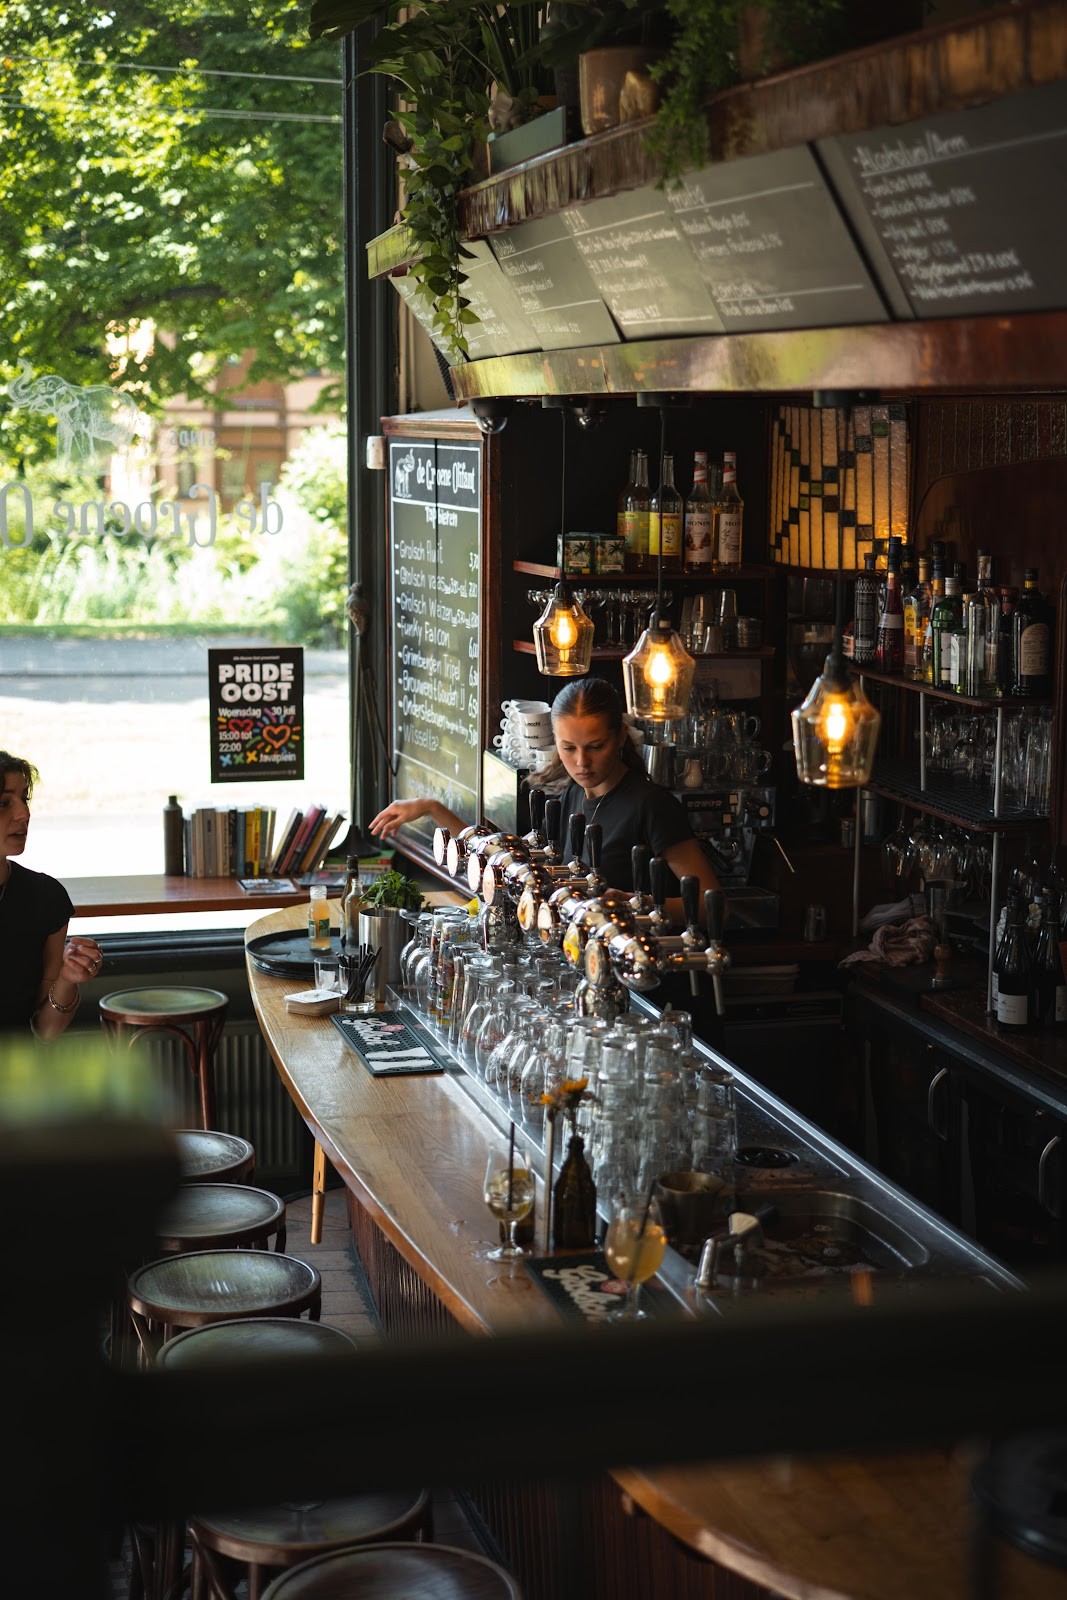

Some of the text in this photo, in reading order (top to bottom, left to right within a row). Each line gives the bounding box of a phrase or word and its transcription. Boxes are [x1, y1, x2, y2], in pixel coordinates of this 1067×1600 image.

[416, 458, 426, 484] de
[425, 459, 451, 490] Groene
[400, 540, 425, 561] Grolsch
[400, 566, 426, 588] Grolsch
[400, 592, 427, 615] Grolsch
[425, 621, 451, 648] Falcon
[402, 645, 442, 676] Grimbergen
[218, 663, 294, 683] PRIDE
[221, 681, 292, 703] OOST
[218, 705, 296, 719] Woensdag 30 juli
[219, 730, 253, 741] 15:00 tot
[219, 742, 242, 753] 22:00
[259, 751, 296, 764] Javaplein
